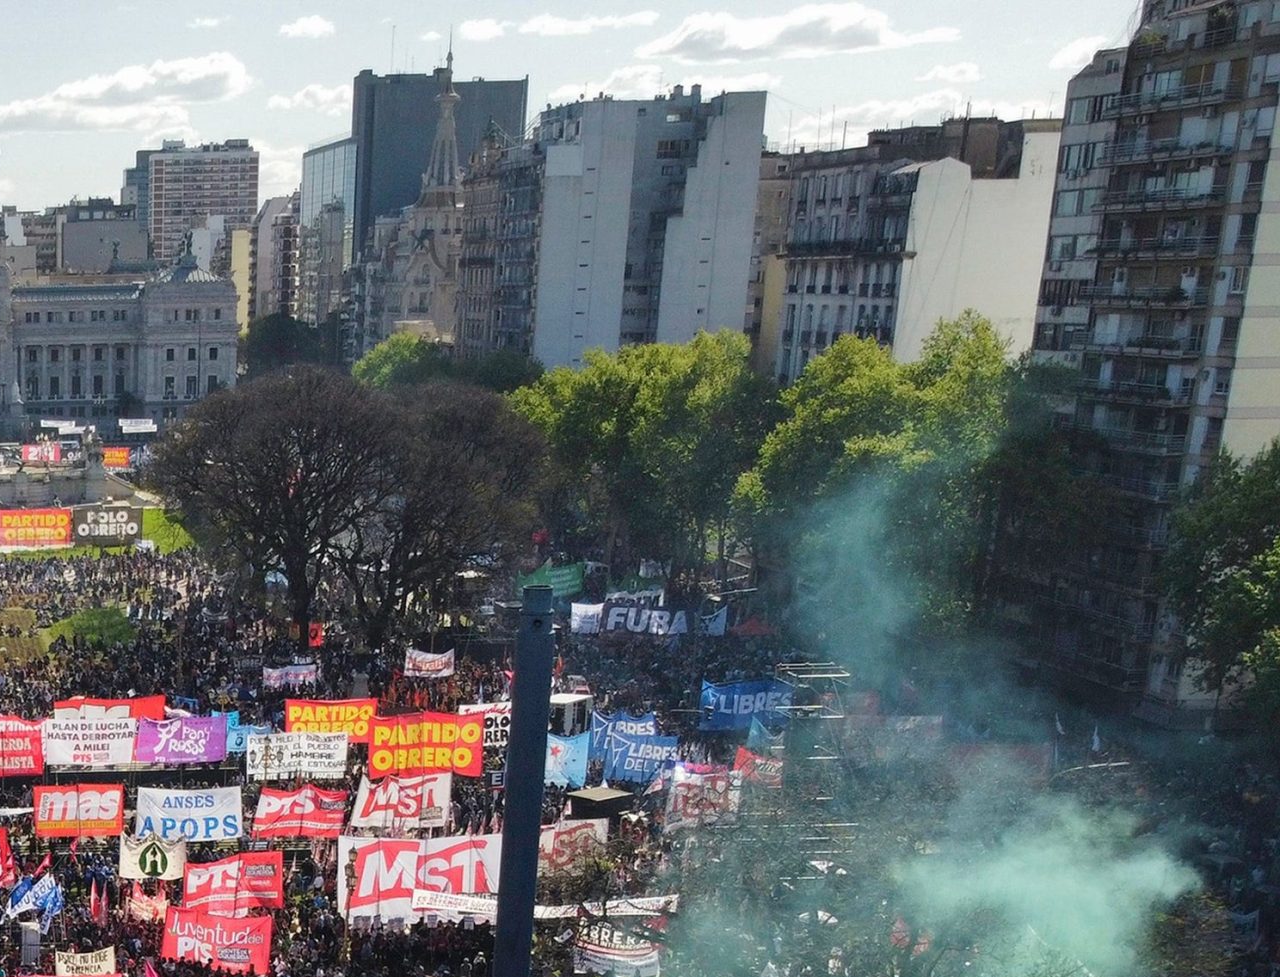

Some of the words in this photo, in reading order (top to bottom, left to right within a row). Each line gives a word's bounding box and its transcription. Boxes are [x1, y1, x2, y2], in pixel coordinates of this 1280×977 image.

[2, 514, 68, 528] PARTIDO
[87, 511, 128, 523] POLO
[4, 528, 67, 541] OBRERO
[78, 523, 138, 538] OBRERO
[606, 607, 688, 635] FUBA
[720, 692, 792, 714] LIBRES
[289, 706, 374, 723] PARTIDO
[47, 731, 79, 741] HASTA
[82, 731, 134, 741] DERROTAR
[52, 722, 79, 731] PLAN
[81, 722, 93, 731] DE
[95, 722, 130, 731] LUCHA
[291, 722, 369, 737] OBRERO
[374, 722, 481, 746] PARTIDO
[73, 753, 92, 763] PTS
[74, 743, 83, 751] A
[84, 743, 110, 752] MILEI
[372, 747, 472, 771] OBRERO
[46, 789, 121, 822] mas
[162, 795, 215, 808] ANSES
[254, 786, 315, 819] PTS
[372, 779, 438, 817] MST
[138, 815, 239, 841] APOPS
[187, 860, 243, 894] PTS
[358, 846, 497, 897] MST
[172, 911, 249, 945] Juventud
[248, 933, 264, 944] del
[177, 936, 212, 964] PTS
